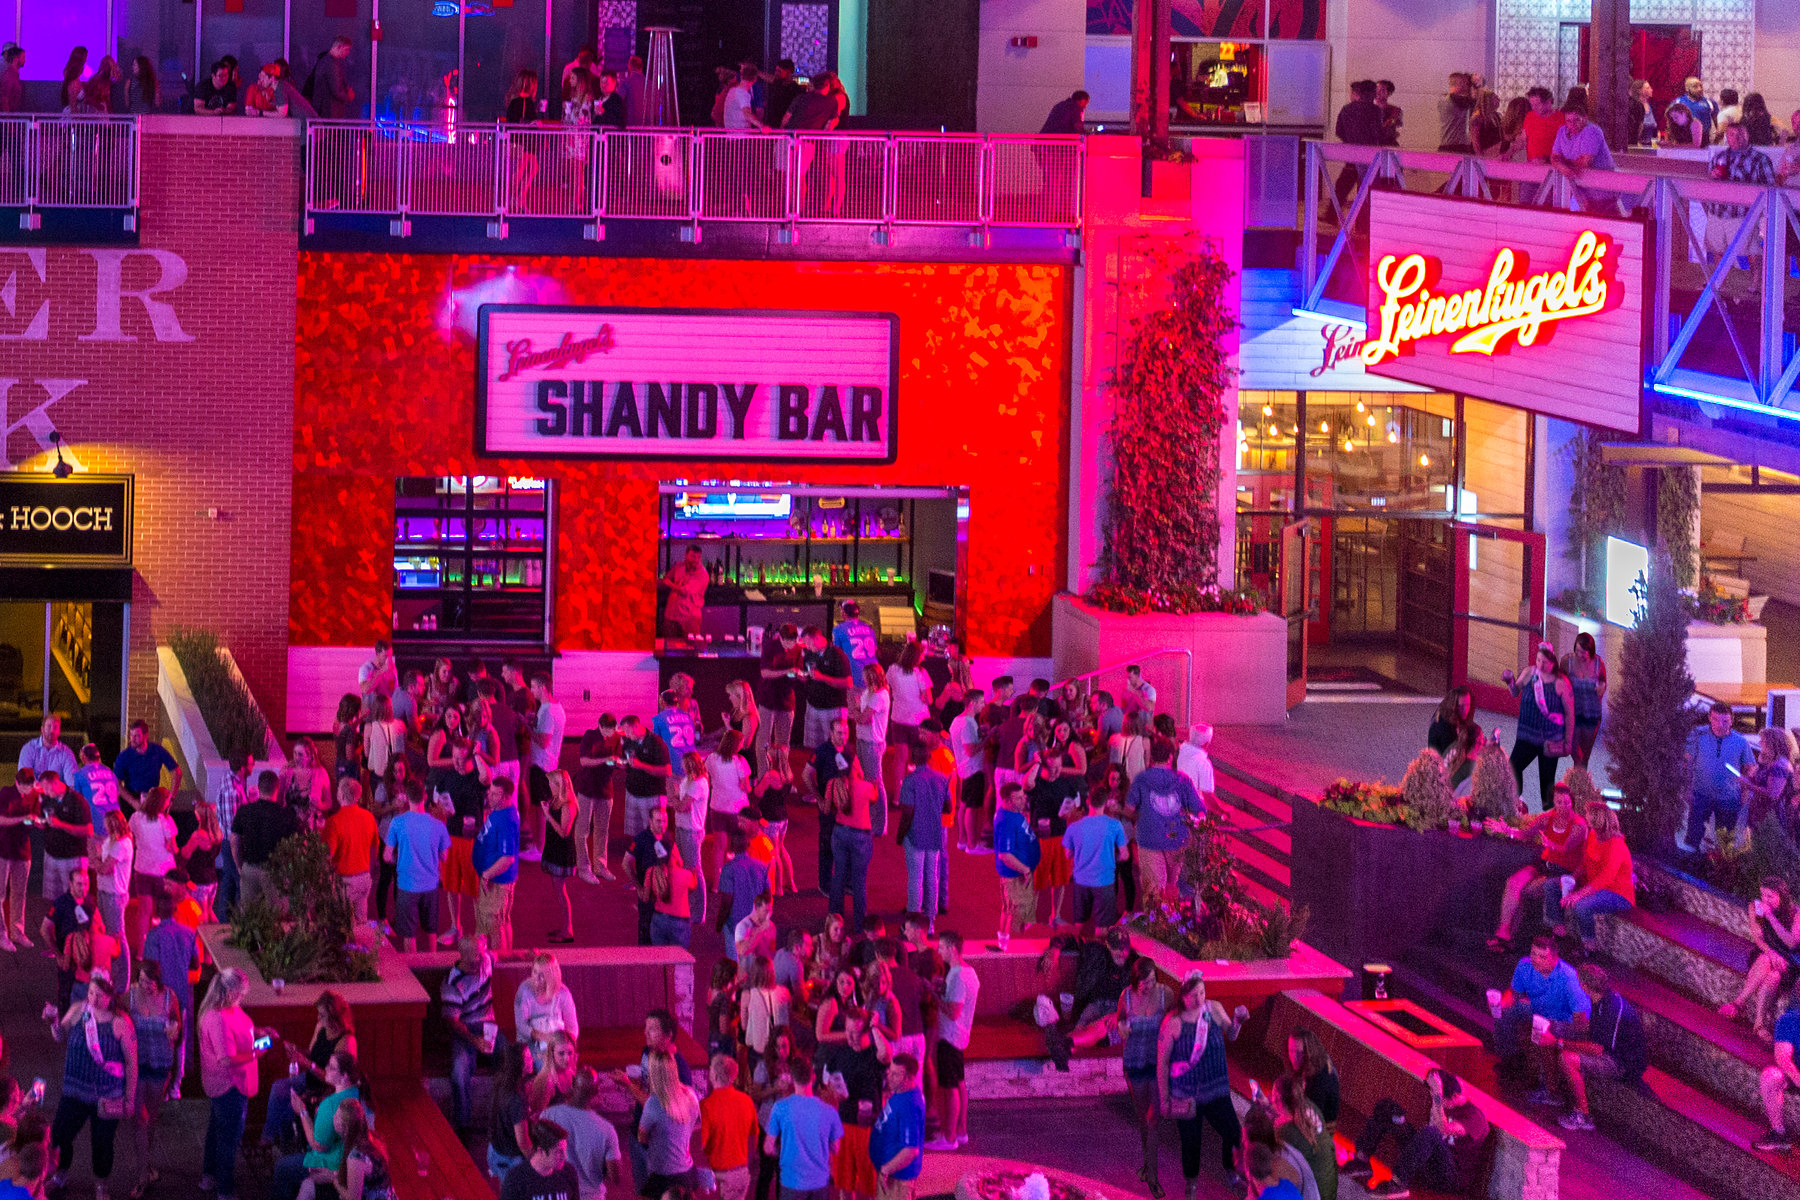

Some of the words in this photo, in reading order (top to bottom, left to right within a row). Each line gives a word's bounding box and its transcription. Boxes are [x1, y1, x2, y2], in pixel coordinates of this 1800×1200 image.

[1361, 230, 1608, 366] Leinenkugel's
[1309, 323, 1366, 377] Lein
[535, 380, 758, 440] SHANDY
[777, 384, 883, 442] BAR
[10, 506, 113, 531] HOOCH
[849, 636, 876, 660] 29
[668, 723, 695, 748] 29
[90, 781, 119, 806] 29
